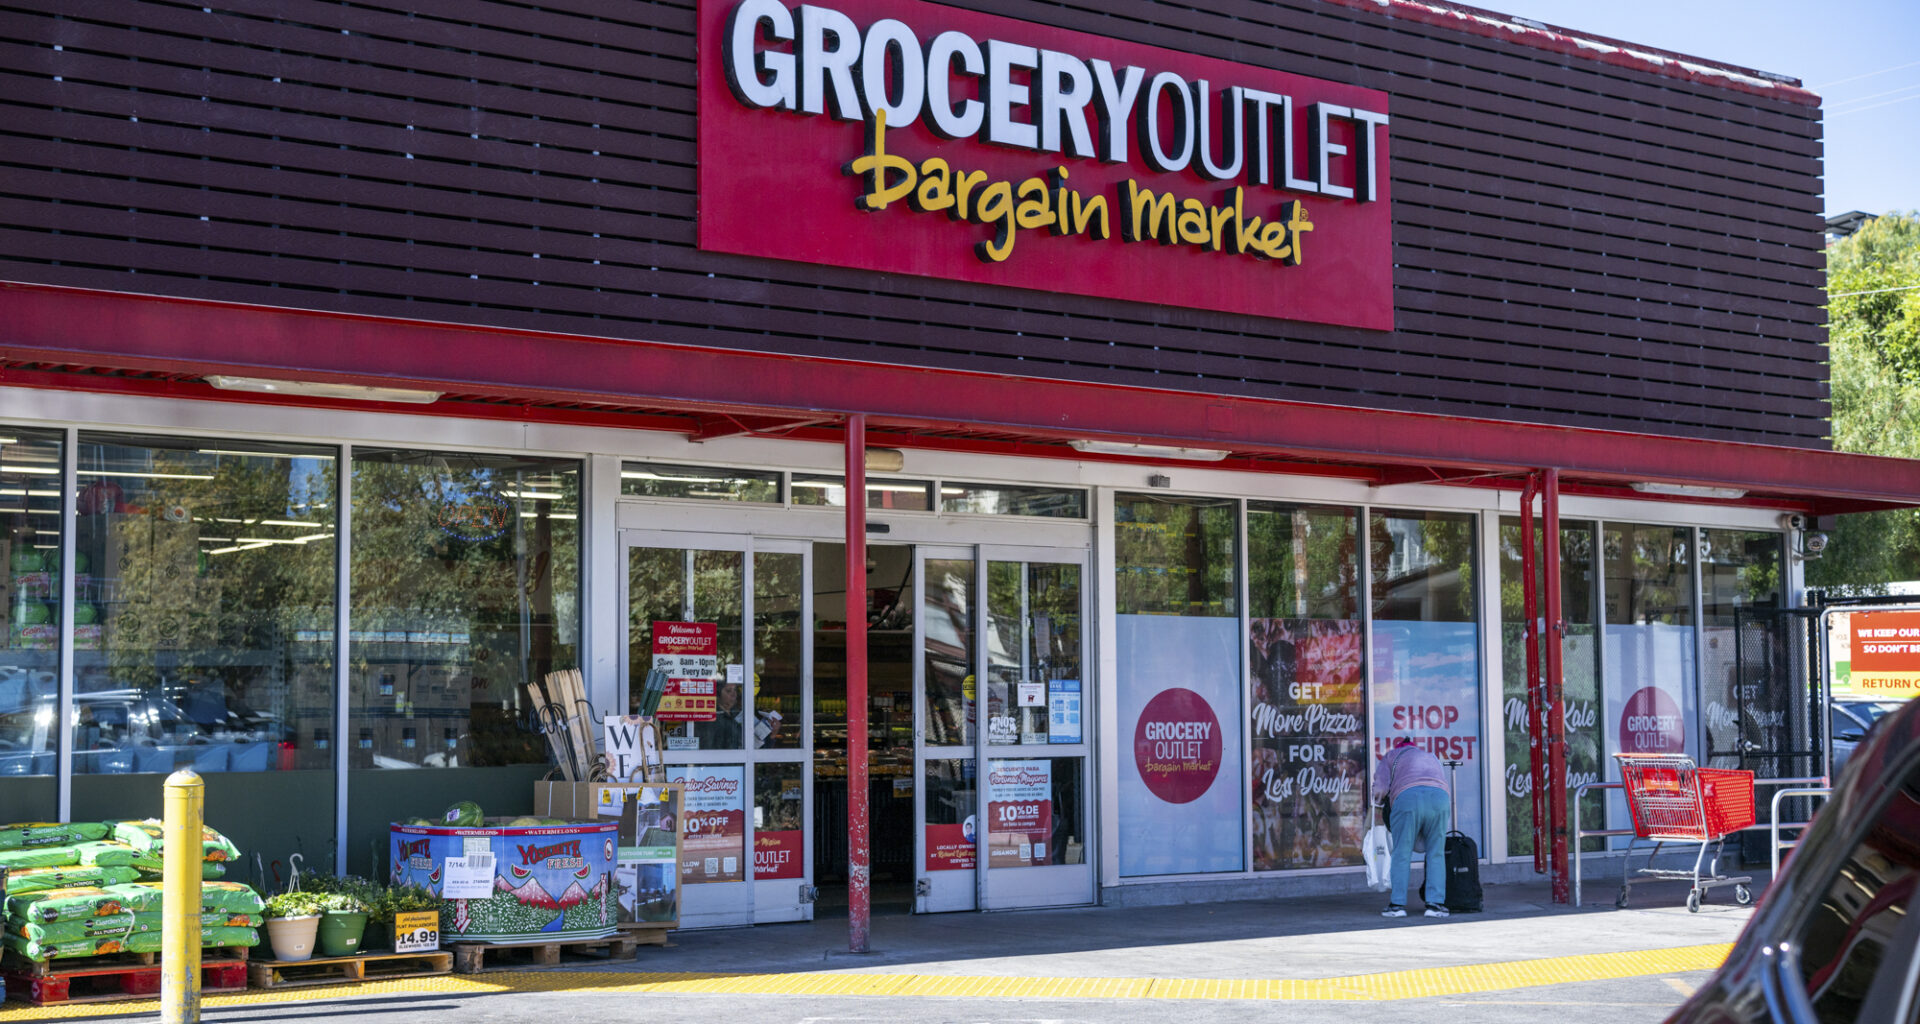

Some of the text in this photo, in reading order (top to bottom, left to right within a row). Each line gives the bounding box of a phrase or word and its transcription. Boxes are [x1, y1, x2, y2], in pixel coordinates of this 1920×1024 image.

[850, 107, 1315, 266] bargain market
[438, 505, 509, 529] OPEN
[22, 627, 41, 637] Gain
[668, 624, 695, 635] Welcome
[1857, 628, 1920, 638] WE KEEP OUR
[1863, 645, 1877, 653] SO
[1878, 644, 1909, 653] DON'T
[682, 668, 700, 677] Every
[701, 668, 713, 676] Day
[1288, 682, 1323, 700] GET
[1862, 678, 1911, 688] RETURN
[1252, 703, 1360, 738] More Pizza
[1392, 705, 1459, 730] SHOP
[1562, 699, 1597, 733] Kale
[1627, 715, 1677, 732] GROCERY
[607, 725, 640, 750] W
[1145, 722, 1212, 740] GROCERY
[1413, 736, 1477, 760] FIRST
[1635, 732, 1671, 749] OUTLET
[1155, 741, 1203, 760] OUTLET
[1289, 744, 1325, 762] FOR
[1145, 756, 1213, 778] bargain market
[704, 776, 739, 795] Savings
[1262, 766, 1352, 803] Less Dough
[32, 826, 56, 834] Garden
[708, 816, 728, 826] OFF
[517, 840, 582, 865] YOSEMITE
[547, 857, 584, 870] FRESH
